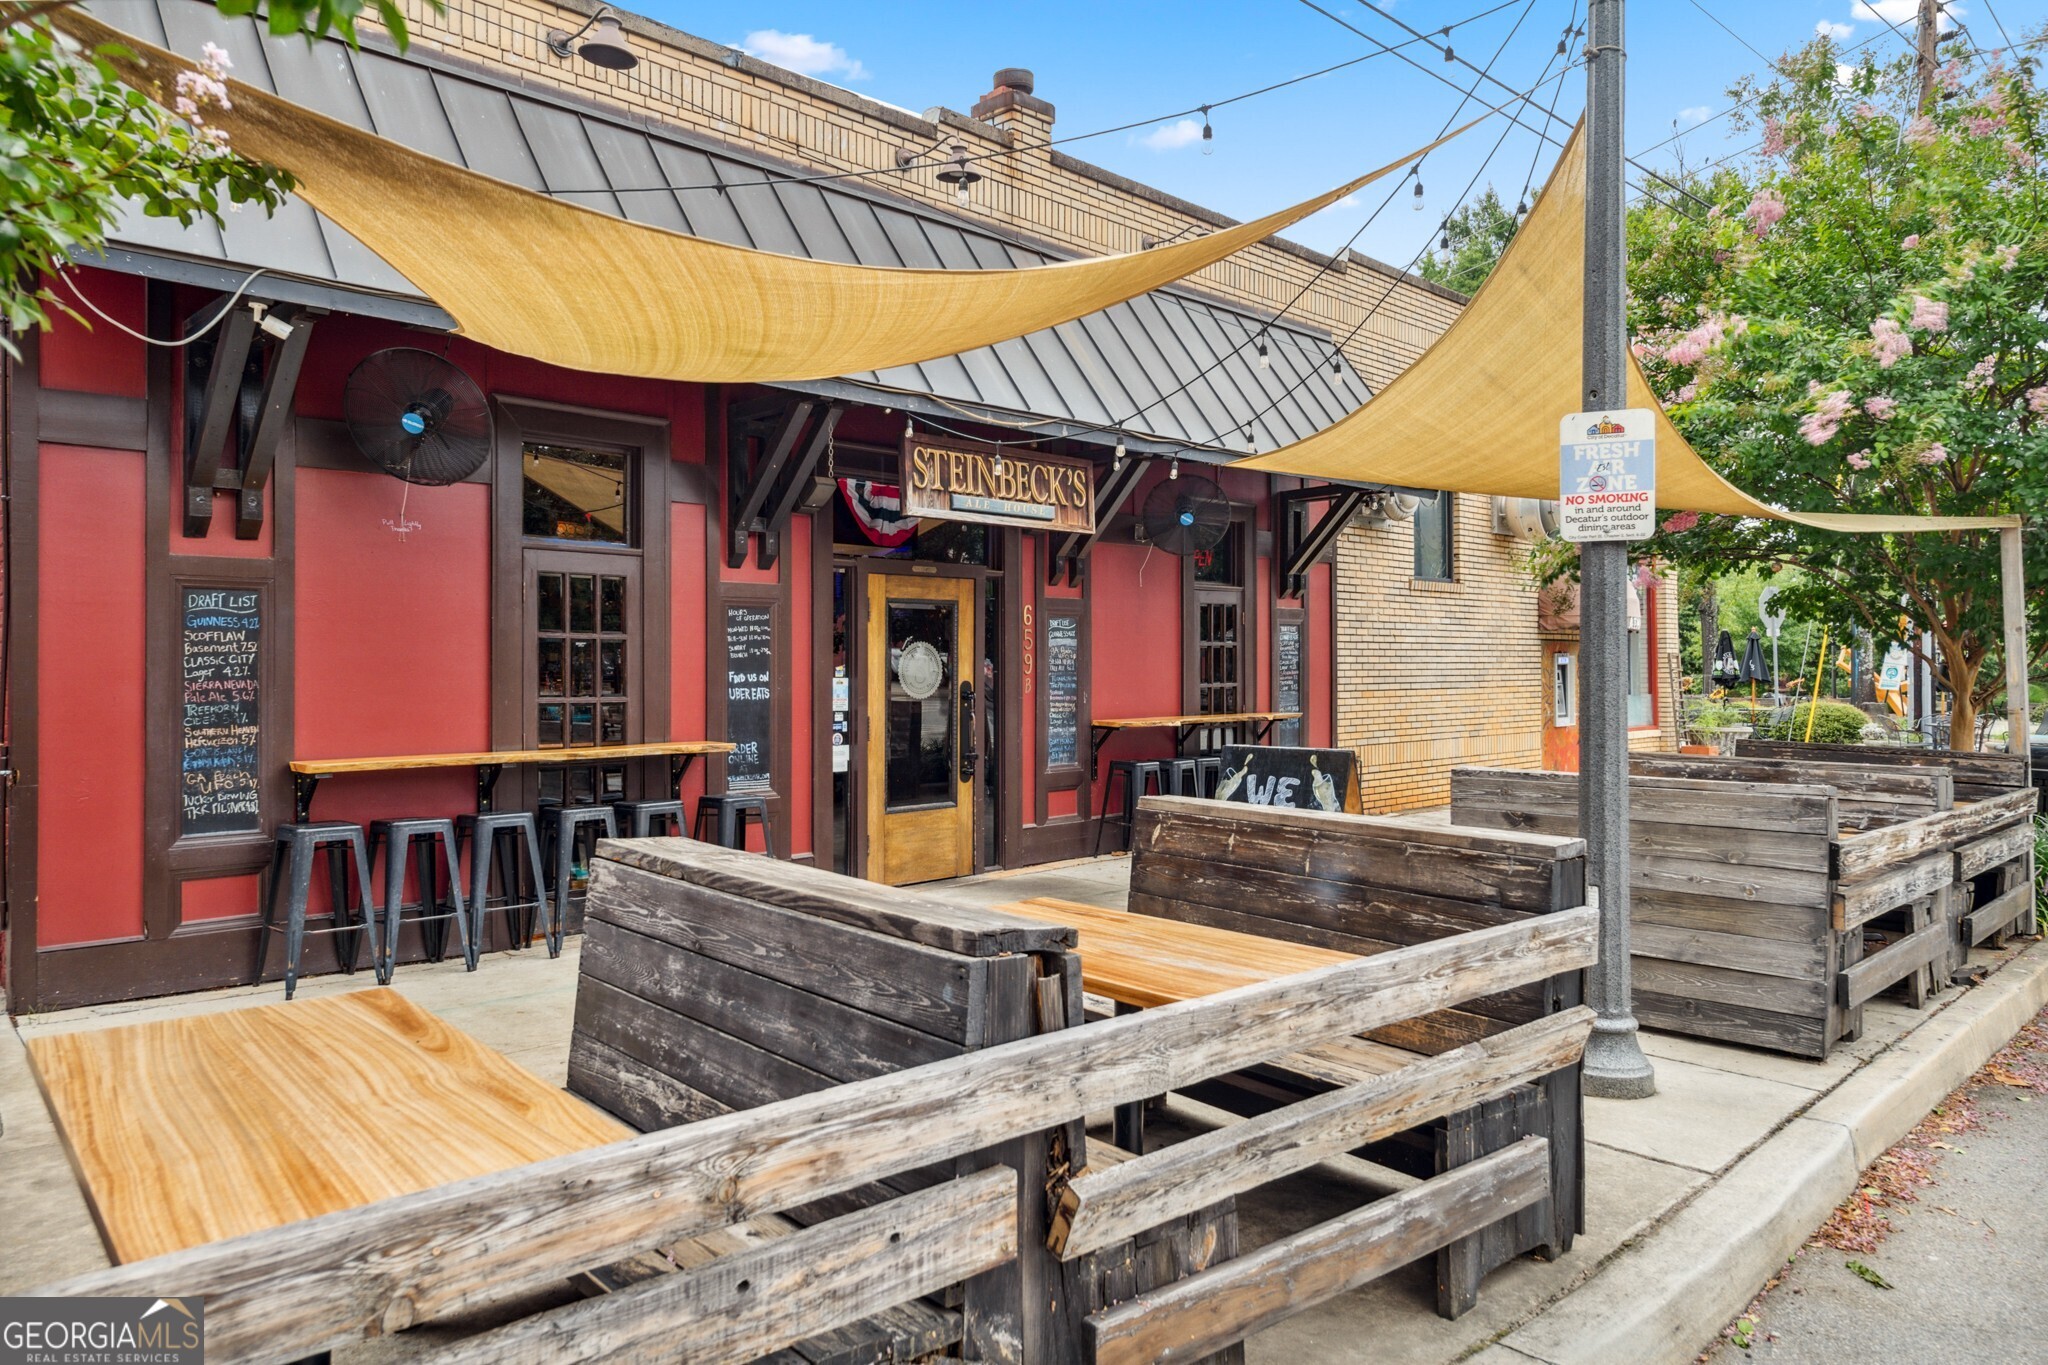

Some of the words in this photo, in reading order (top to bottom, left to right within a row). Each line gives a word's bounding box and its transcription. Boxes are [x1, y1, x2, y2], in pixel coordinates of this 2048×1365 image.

[1573, 441, 1641, 461] FRESH
[1588, 459, 1626, 476] AIR
[912, 445, 1087, 508] STEINBECK'S
[1565, 495, 1585, 506] NO
[1588, 492, 1649, 505] SMOKING
[965, 498, 991, 510] ALE
[1003, 500, 1047, 516] HOUSE
[1586, 505, 1605, 514] and
[1606, 503, 1642, 513] around
[1565, 514, 1608, 524] Decatur's
[1610, 512, 1650, 522] outdoor
[1577, 523, 1609, 533] dining
[1610, 522, 1636, 531] areas
[1193, 549, 1215, 567] PEN
[188, 592, 227, 608] DRAFT
[229, 594, 258, 607] LIST
[186, 614, 241, 629] GUINNESS
[184, 629, 246, 642] SCOFFLAW
[183, 642, 240, 655] Basement
[229, 653, 256, 665] CITY
[184, 667, 216, 682] Lager
[222, 665, 251, 677] 4.2%
[747, 672, 757, 683] US
[758, 671, 770, 683] ON
[184, 680, 223, 692] SIERRA
[223, 679, 260, 691] NEVADA
[184, 690, 207, 704] Pale
[208, 691, 228, 702] Ale
[232, 690, 256, 702] 5.6%
[728, 687, 751, 700] UBER
[751, 686, 770, 700] EATS
[728, 754, 760, 765] ONLINE
[186, 772, 207, 785] GA
[200, 779, 234, 795] UFO
[1246, 773, 1301, 809] WE
